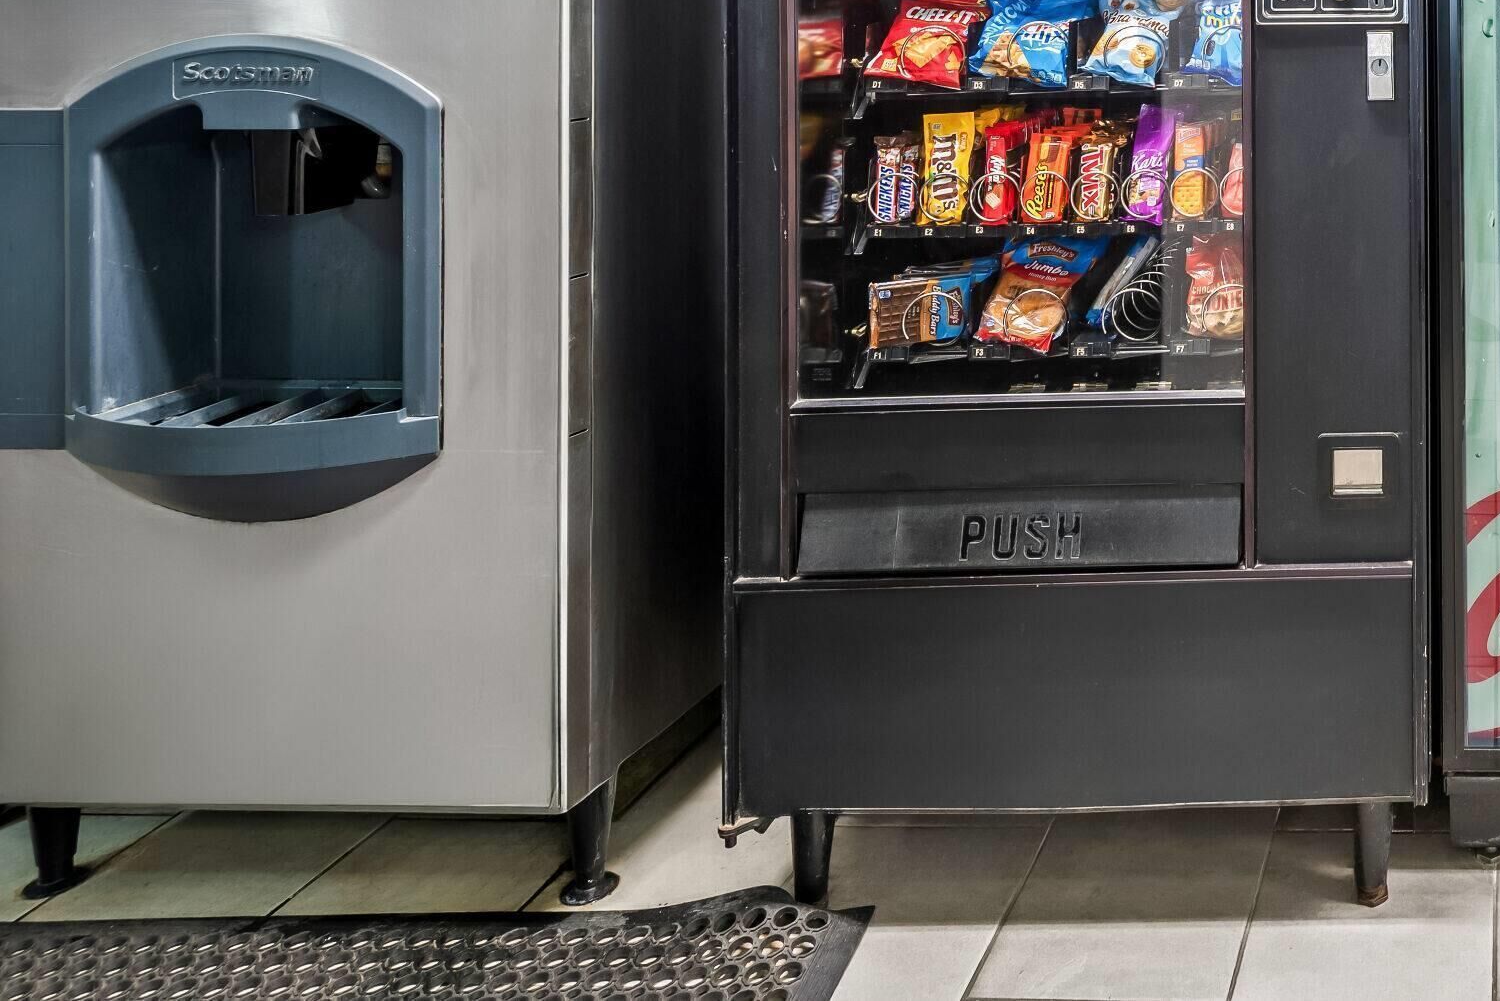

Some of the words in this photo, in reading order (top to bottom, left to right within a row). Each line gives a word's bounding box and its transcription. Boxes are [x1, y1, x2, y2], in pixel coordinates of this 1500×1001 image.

[183, 61, 314, 84] Scotsman
[872, 80, 881, 89] D1
[973, 81, 983, 89] D3
[1074, 81, 1084, 89] D5
[1131, 150, 1163, 172] Kar's
[1081, 145, 1104, 211] TWIX
[878, 166, 895, 222] SNICKERS
[1026, 160, 1049, 220] Reese's
[975, 226, 984, 234] E3
[1076, 226, 1085, 234] E5
[1126, 225, 1135, 233] E6
[1176, 223, 1185, 231] E7
[1226, 222, 1235, 230] E8
[874, 228, 882, 236] E1
[1026, 227, 1035, 235] E4
[1032, 243, 1076, 258] Freshley's
[1024, 260, 1070, 277] Jumbo
[929, 314, 940, 336] Bars
[975, 349, 984, 357] F3
[1076, 348, 1085, 356] F5
[1175, 345, 1184, 353] F7
[873, 352, 882, 360] F1
[958, 511, 1083, 562] PUSH
